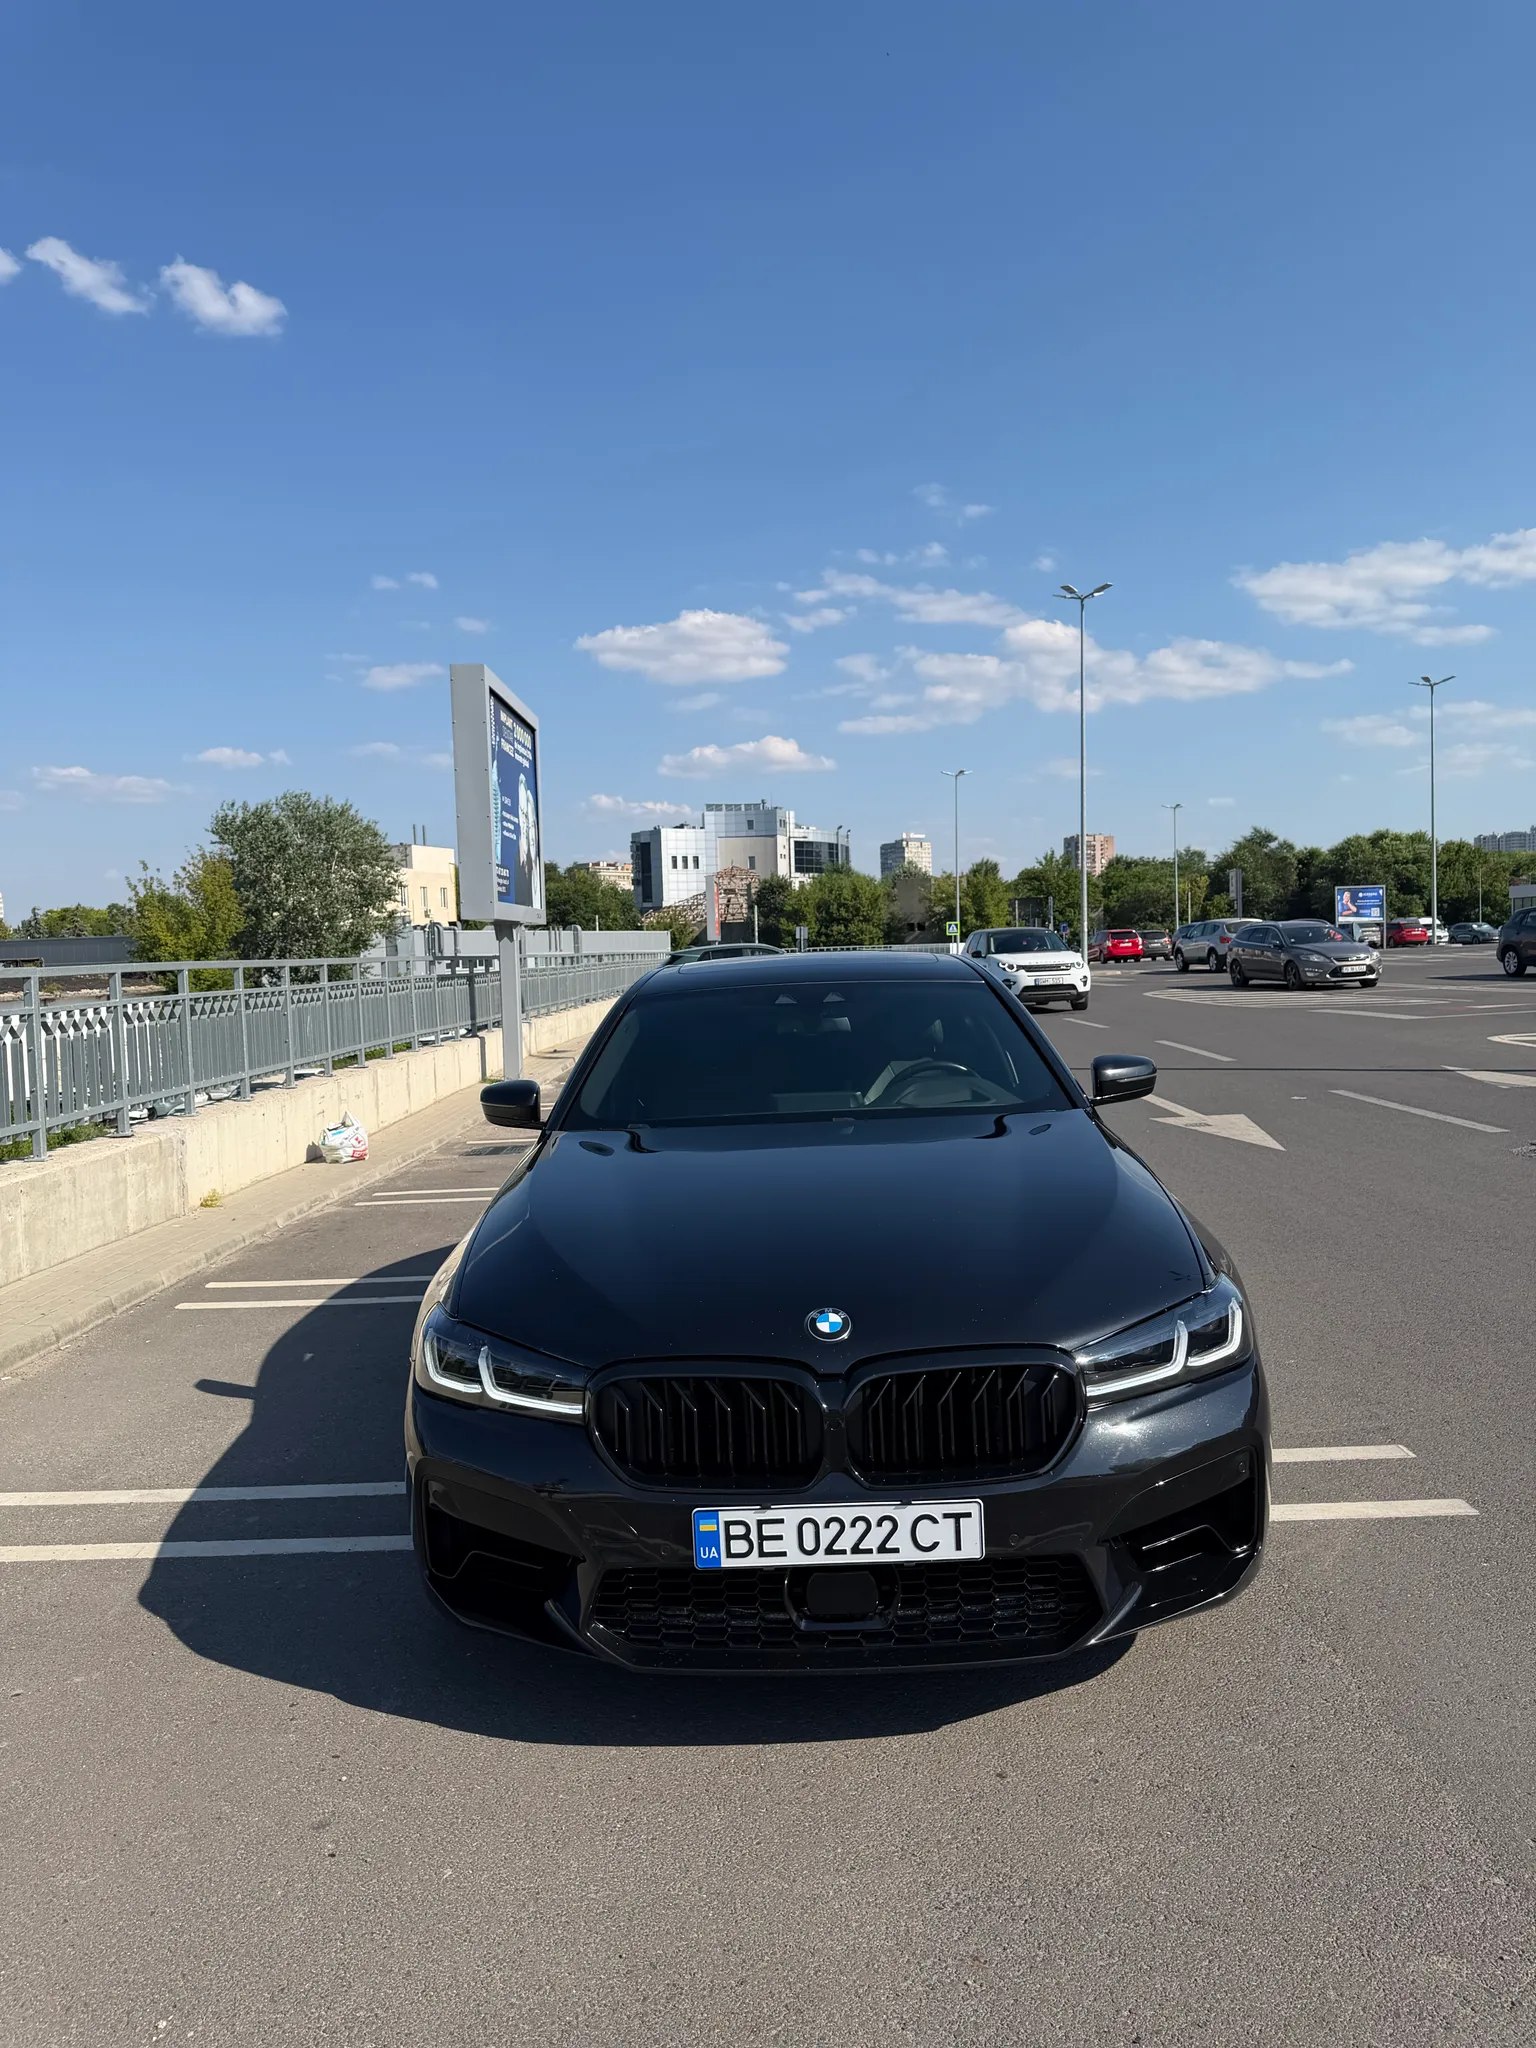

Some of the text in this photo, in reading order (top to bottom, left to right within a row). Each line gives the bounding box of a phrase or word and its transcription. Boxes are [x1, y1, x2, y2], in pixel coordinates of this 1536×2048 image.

[813, 1307, 847, 1319] BMW
[724, 1511, 973, 1558] BE 0222 CT
[700, 1546, 719, 1560] UA
